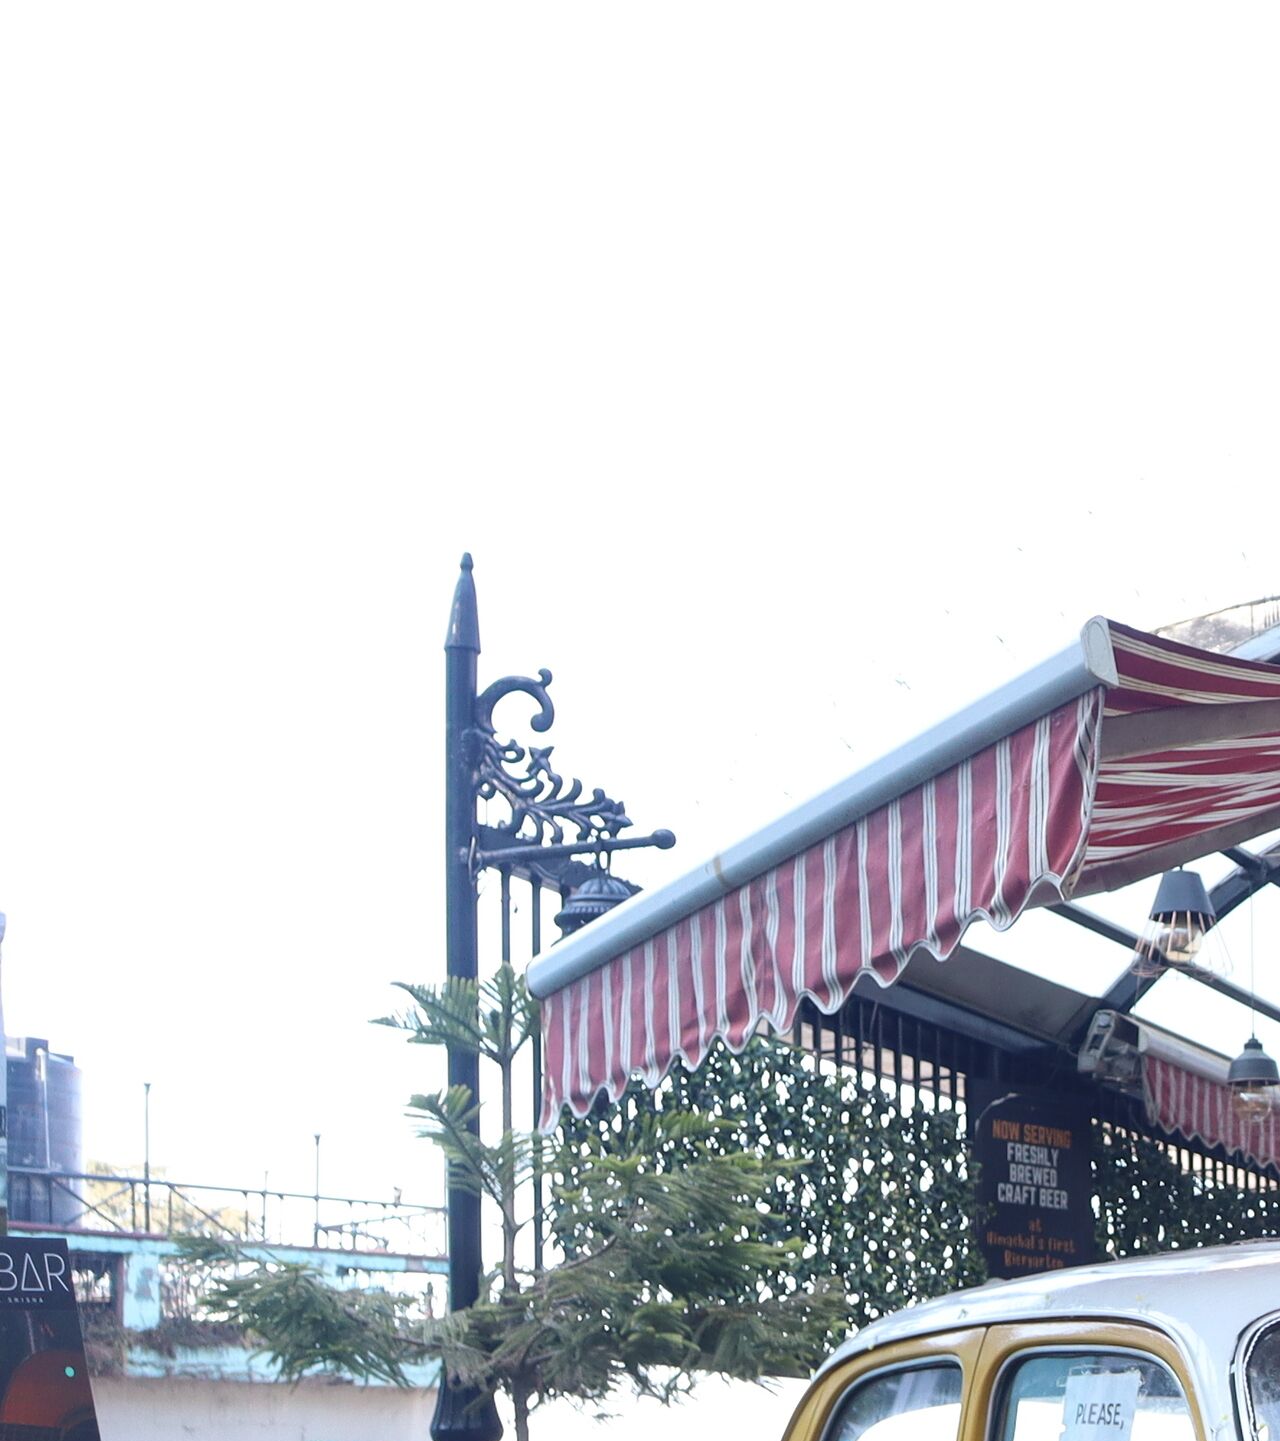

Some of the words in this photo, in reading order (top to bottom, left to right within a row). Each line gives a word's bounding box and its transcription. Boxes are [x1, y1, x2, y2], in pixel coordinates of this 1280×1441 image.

[992, 1119, 1020, 1140] NOW
[1023, 1124, 1072, 1148] SERVING
[1007, 1142, 1059, 1167] FRESHLY
[1009, 1163, 1058, 1188] BREWED
[998, 1183, 1036, 1206] CRAFT
[1039, 1188, 1068, 1210] BEER
[1075, 1403, 1124, 1431] PLEASE,
